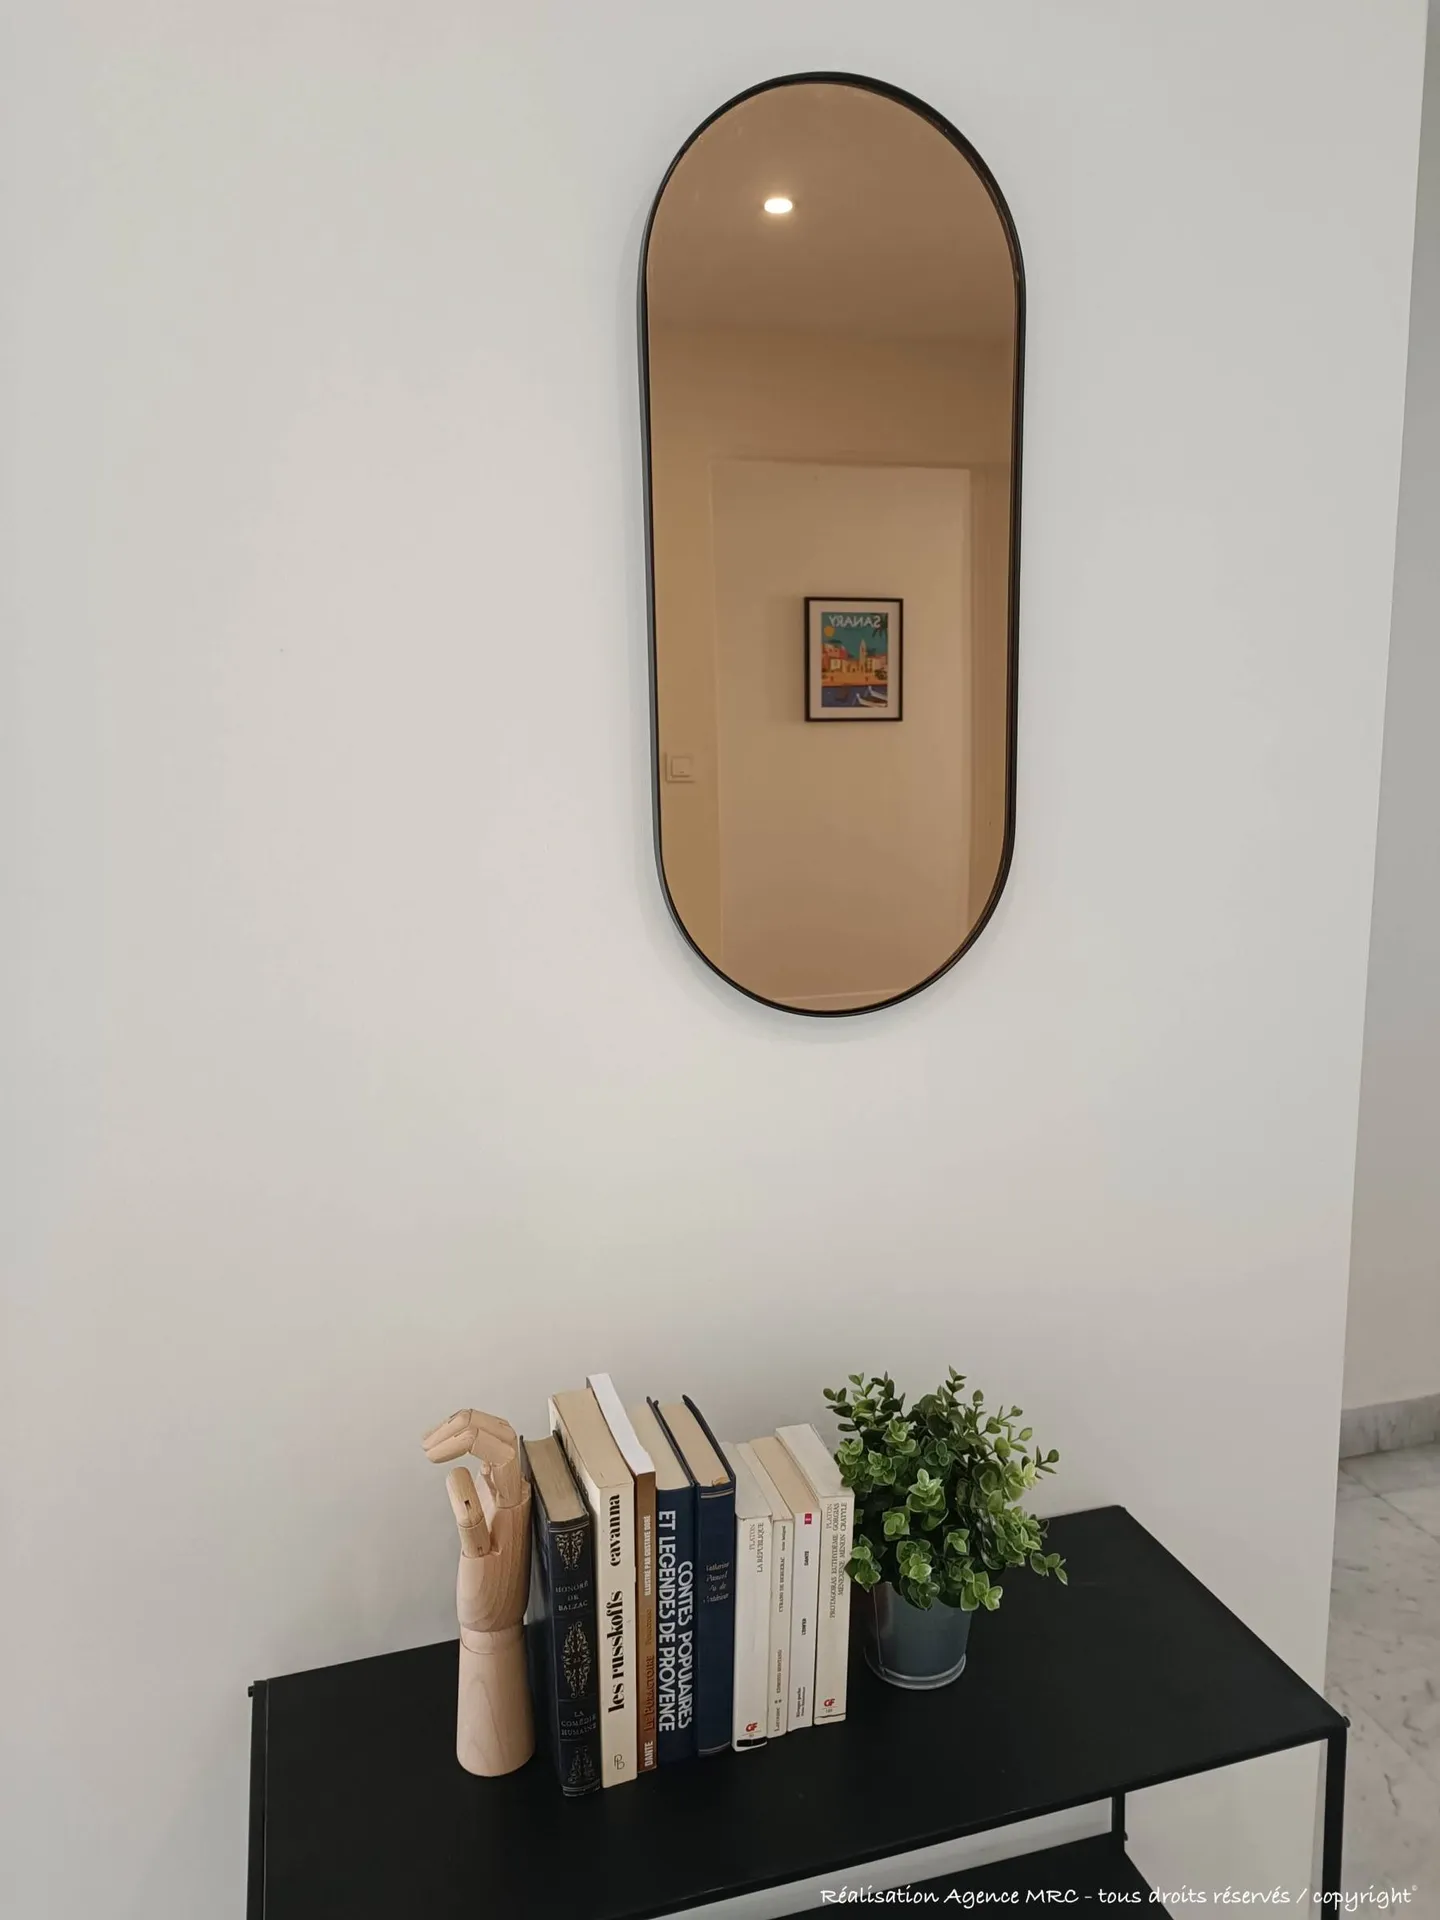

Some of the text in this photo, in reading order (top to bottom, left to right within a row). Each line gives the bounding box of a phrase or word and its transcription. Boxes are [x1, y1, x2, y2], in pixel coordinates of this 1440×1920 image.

[609, 1494, 621, 1566] cavanna
[757, 1563, 764, 1573] LA
[558, 1600, 588, 1611] BALZAC
[658, 1510, 676, 1732] ET LEGENDES DE PROVENCE
[606, 1590, 625, 1713] les russkoffs
[677, 1561, 693, 1729] CONTES POPULAIRES
[644, 1740, 654, 1767] DANTE
